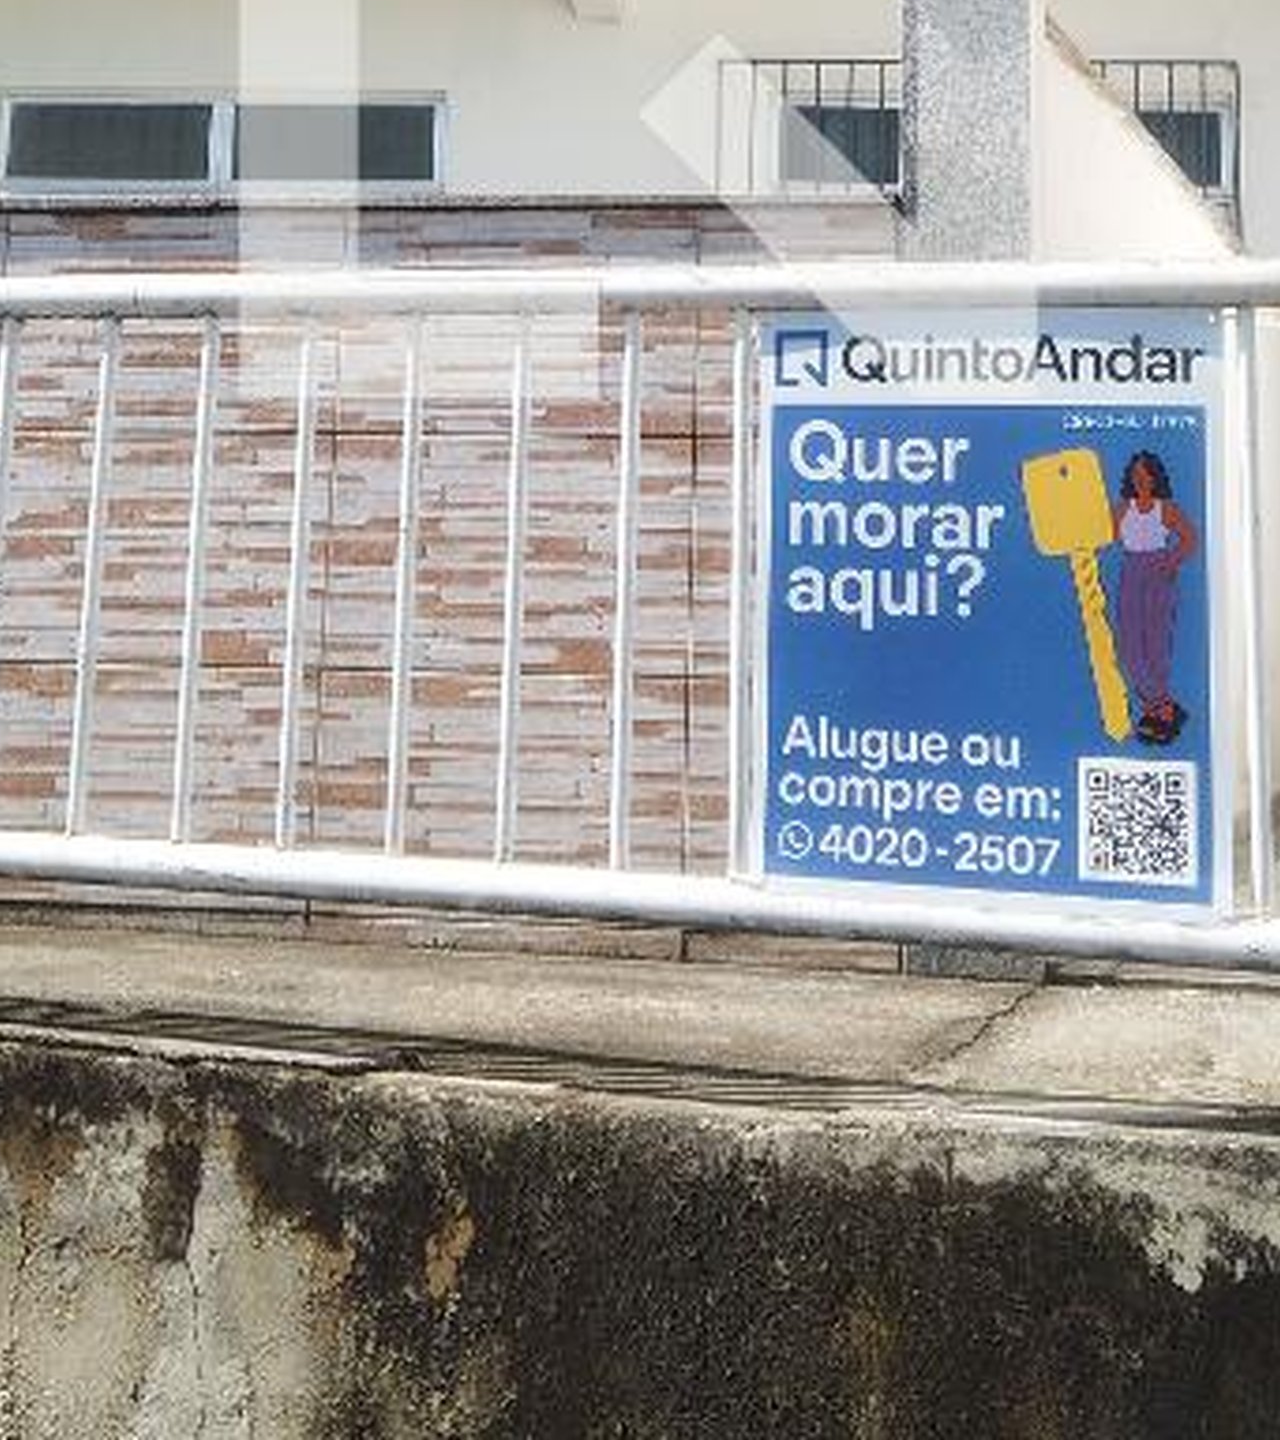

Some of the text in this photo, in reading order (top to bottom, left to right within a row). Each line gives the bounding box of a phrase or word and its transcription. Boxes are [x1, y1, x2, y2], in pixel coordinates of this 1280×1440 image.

[842, 334, 1203, 384] QuintoAndar
[789, 419, 969, 483] Quer
[788, 497, 1004, 549] morar
[786, 555, 986, 630] aqui?
[781, 716, 1021, 770] Alugue ou
[779, 774, 1062, 825] compre em:
